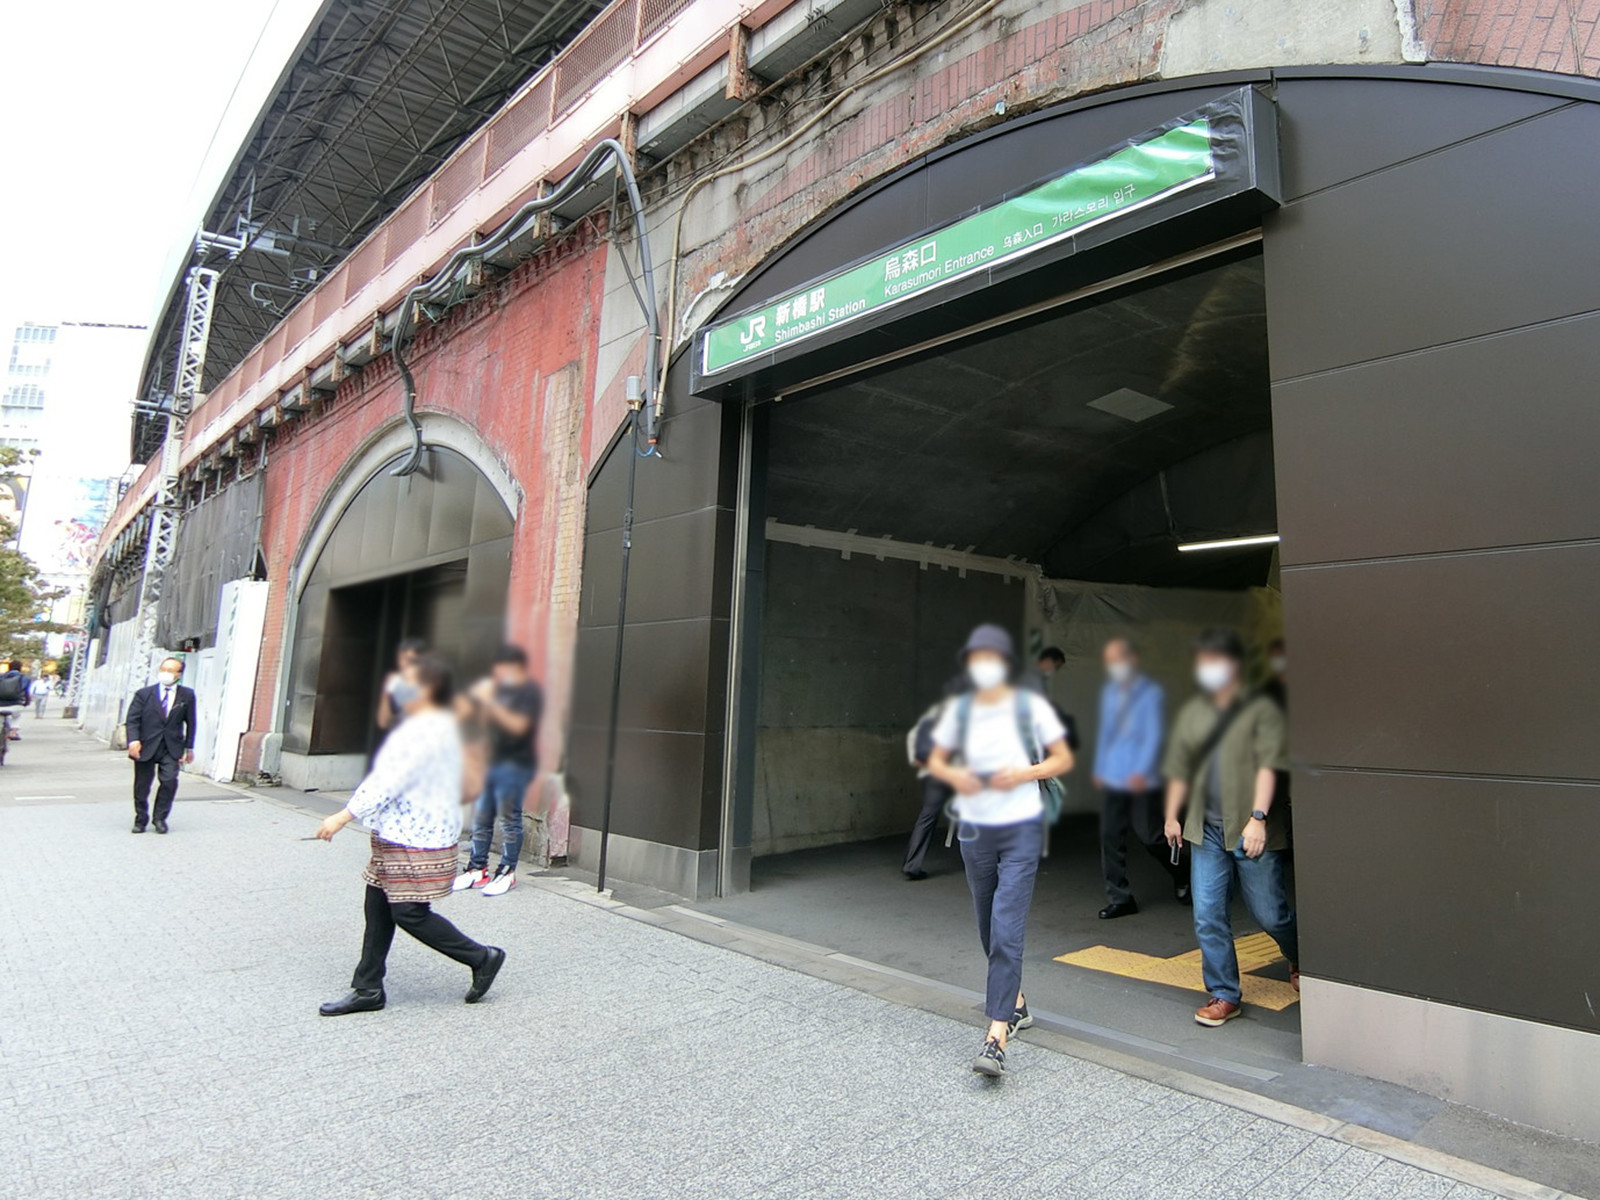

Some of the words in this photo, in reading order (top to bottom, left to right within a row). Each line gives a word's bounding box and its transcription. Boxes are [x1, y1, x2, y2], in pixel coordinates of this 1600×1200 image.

[1051, 195, 1109, 228] 가라스모리
[1113, 183, 1136, 205] 입구
[884, 240, 937, 282] 烏森口
[884, 263, 942, 297] Karasumori
[944, 245, 995, 273] Entrance
[775, 287, 826, 327] 新橋駅
[775, 313, 826, 343] Shimbashi
[828, 298, 866, 322] Station
[740, 315, 766, 345] JR
